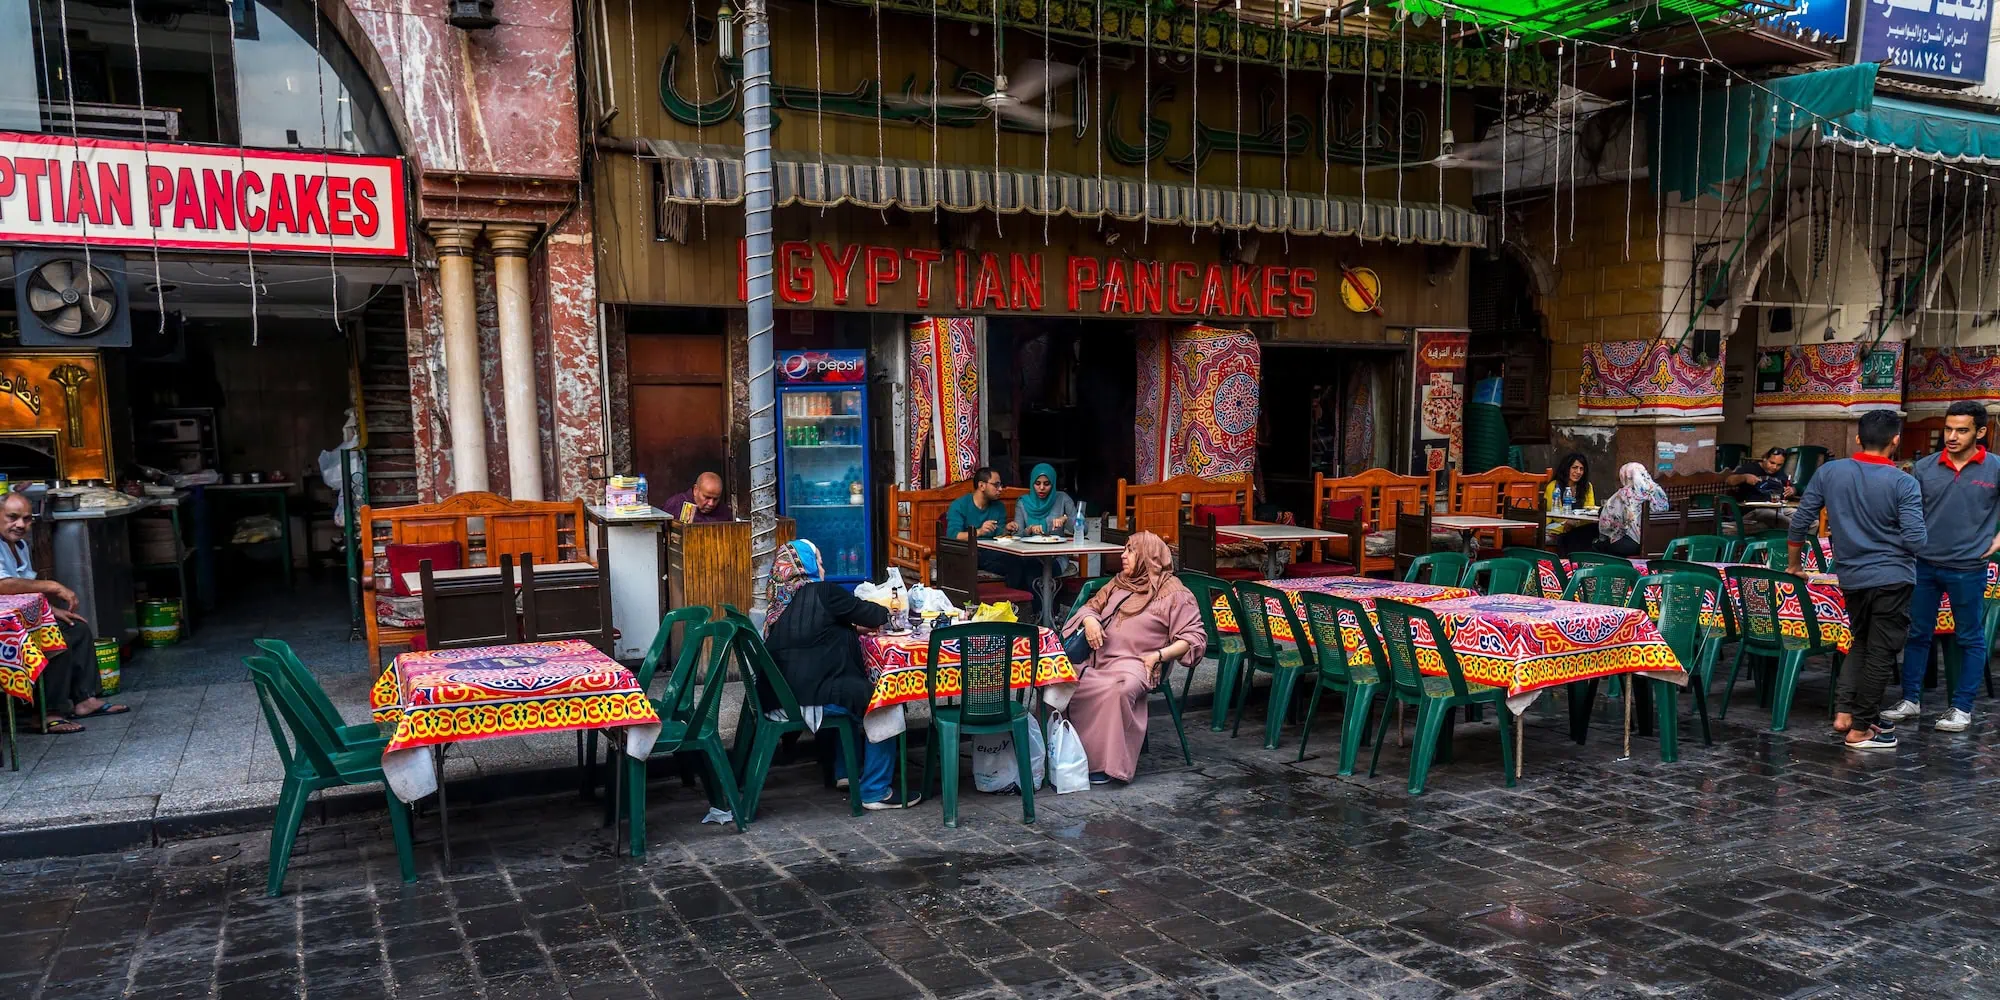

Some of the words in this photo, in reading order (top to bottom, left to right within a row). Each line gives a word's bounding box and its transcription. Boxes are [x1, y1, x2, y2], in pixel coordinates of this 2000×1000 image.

[144, 164, 379, 238] PANCAKES
[1067, 255, 1318, 318] PANCAKES
[817, 358, 857, 373] pepsi
